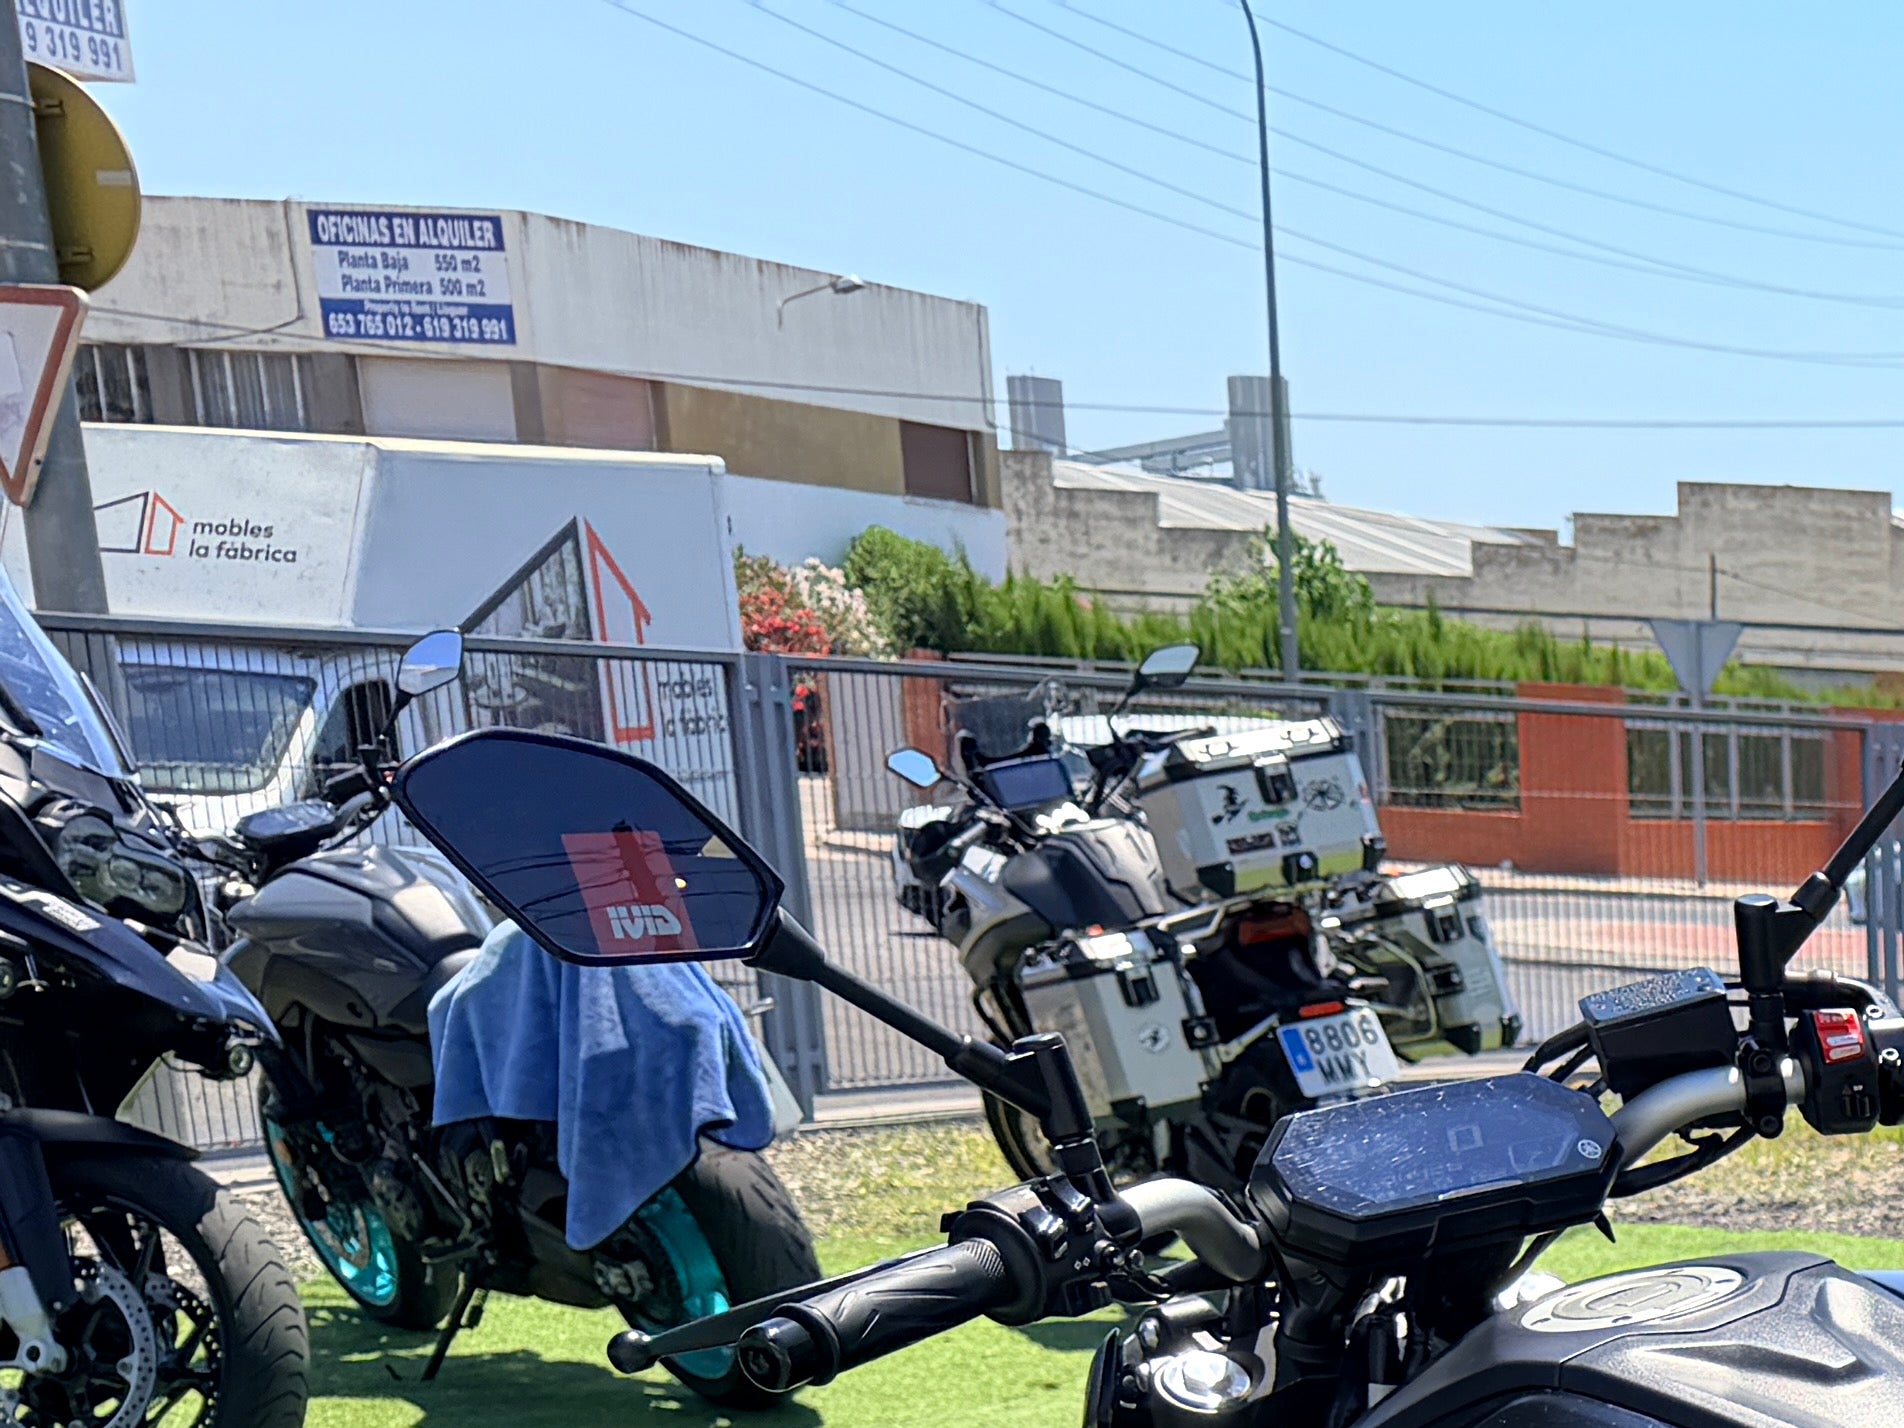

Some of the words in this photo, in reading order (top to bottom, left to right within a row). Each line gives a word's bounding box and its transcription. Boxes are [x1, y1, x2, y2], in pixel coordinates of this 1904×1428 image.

[45, 25, 81, 62] 319
[88, 35, 122, 71] 991
[317, 214, 391, 243] OFICINAS
[392, 217, 415, 244] EN
[419, 218, 496, 248] ALQUILER
[337, 250, 378, 269] Planta
[380, 251, 409, 273] Baja
[434, 253, 458, 273] 550
[460, 255, 481, 273] m2
[341, 274, 381, 293] Planta
[384, 275, 433, 296] Primera
[439, 278, 463, 296] 500
[465, 278, 486, 297] m2
[328, 312, 356, 335] 653
[357, 315, 385, 336] 765
[386, 315, 415, 337] 012
[423, 317, 450, 338] 619
[453, 318, 481, 339] 319
[481, 319, 508, 341] 991
[192, 517, 274, 538] mobles
[188, 538, 210, 559] la
[1304, 1014, 1379, 1055] 8806
